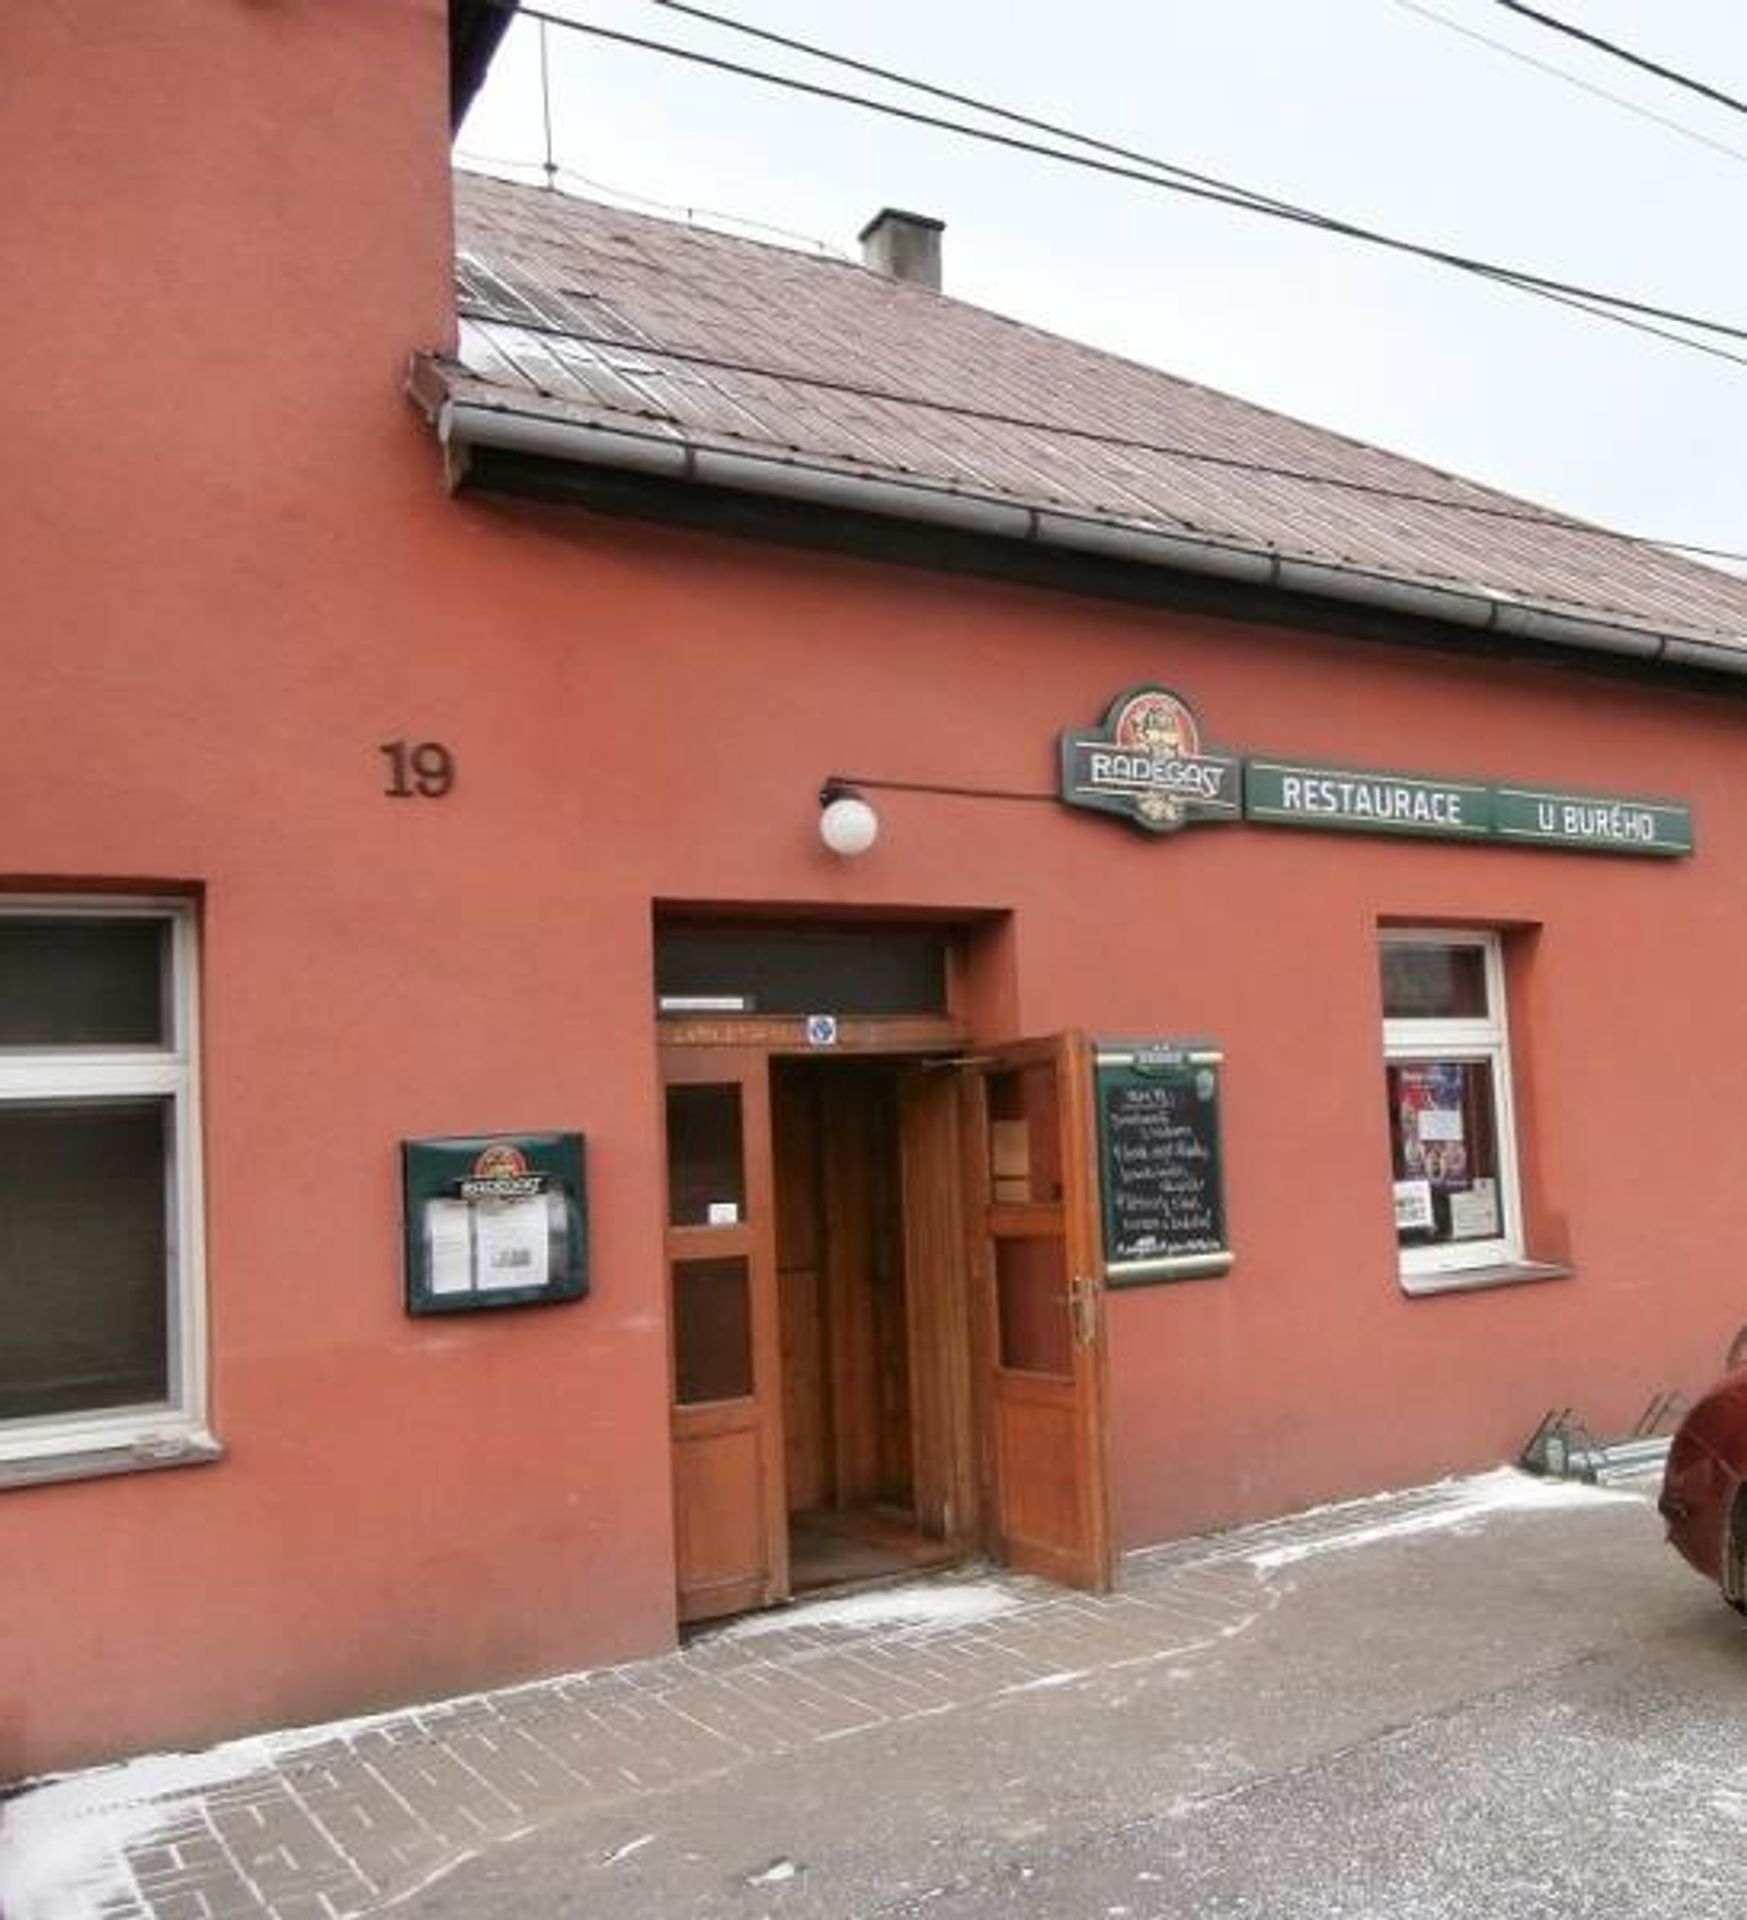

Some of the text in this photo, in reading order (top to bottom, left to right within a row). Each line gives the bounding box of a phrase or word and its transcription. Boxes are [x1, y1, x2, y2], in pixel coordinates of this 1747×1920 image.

[379, 740, 455, 798] 19
[1090, 753, 1225, 798] RADEGAST
[1282, 777, 1655, 840] RESTAURACE U BURÉHO
